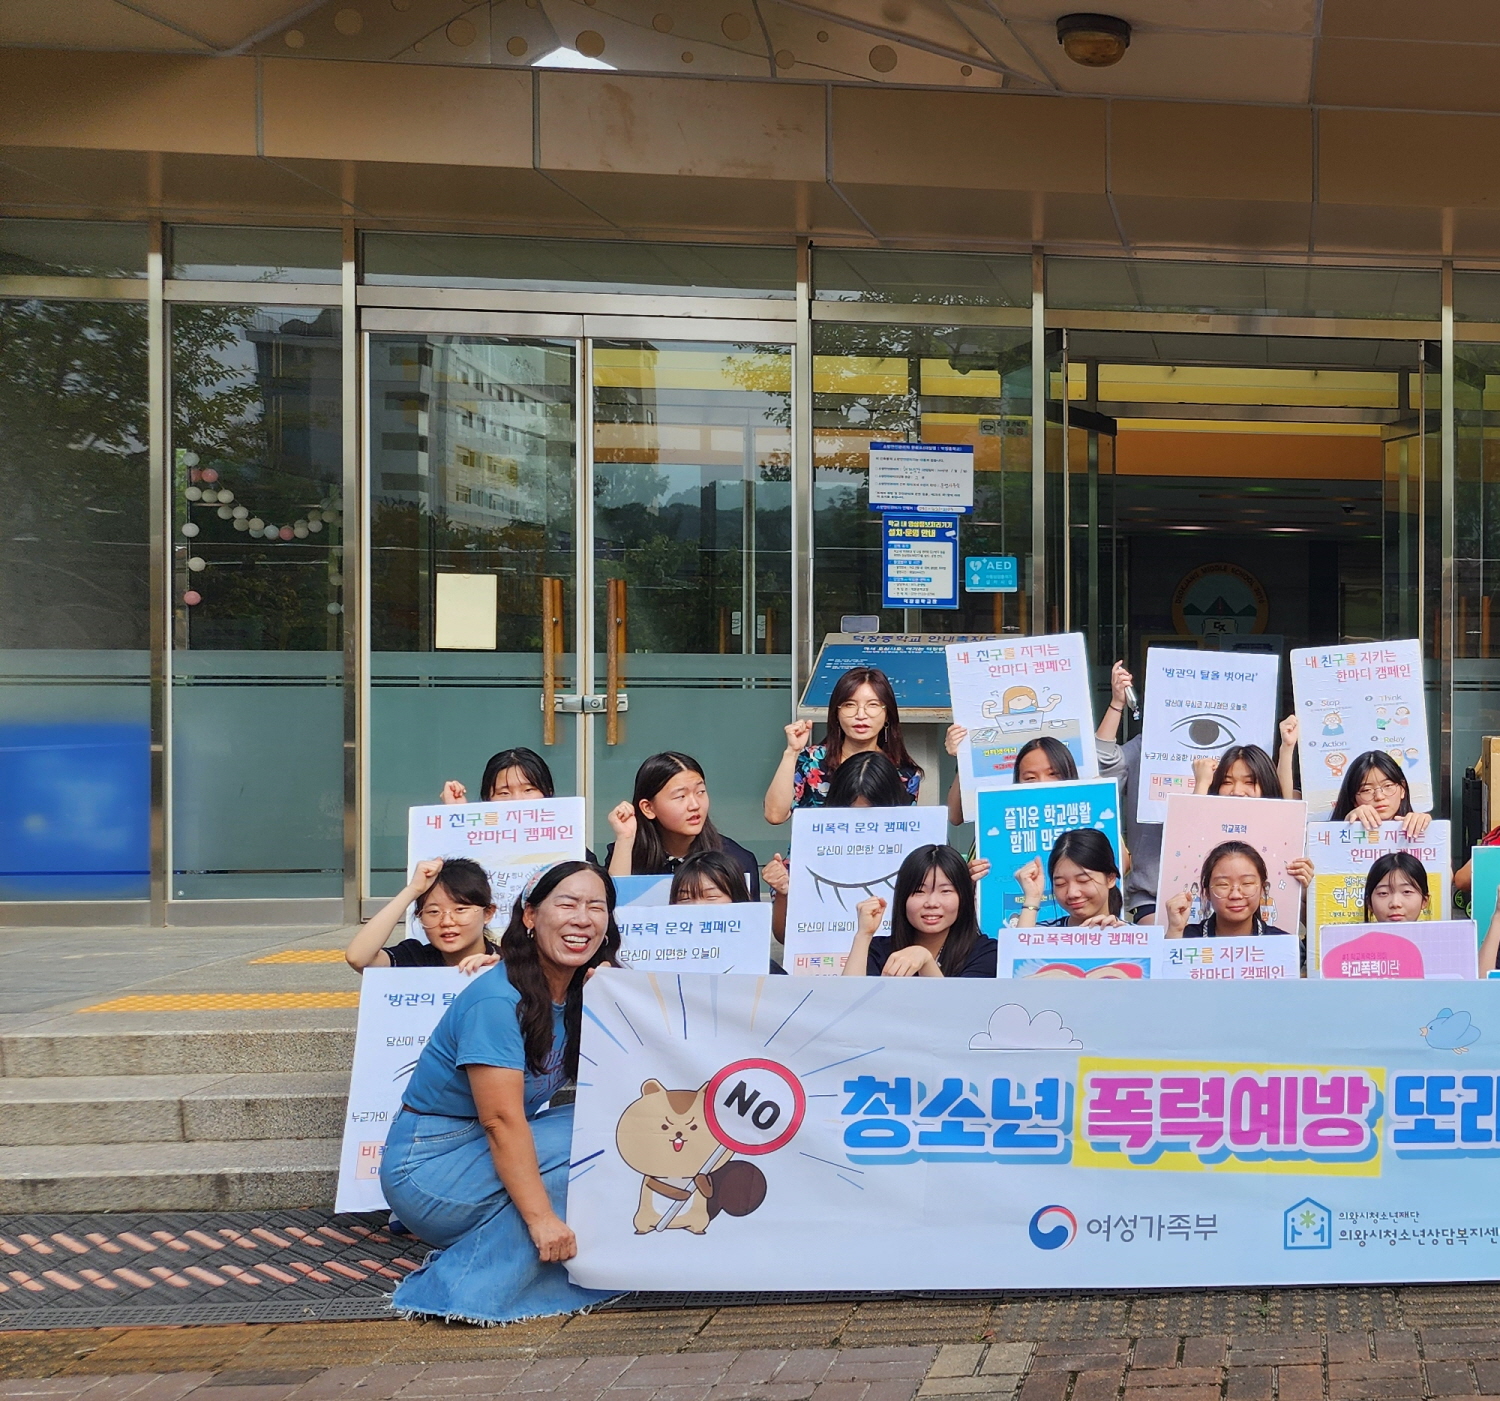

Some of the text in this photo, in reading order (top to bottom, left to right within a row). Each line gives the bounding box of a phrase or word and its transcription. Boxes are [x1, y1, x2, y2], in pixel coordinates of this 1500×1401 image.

[987, 561, 1012, 570] AED
[957, 651, 970, 664] 내
[976, 649, 1016, 662] 친구를
[1021, 644, 1060, 658] 지키는
[1305, 649, 1397, 668] 내 친구를 지키는
[988, 659, 1072, 678] 한마디 캠페인
[1200, 670, 1220, 681] 탈을
[1336, 664, 1411, 683] 한마디 캠페인
[1320, 699, 1340, 708] Stop
[1379, 694, 1403, 702] Think
[1322, 740, 1347, 748] Action
[1383, 735, 1406, 744] Relay
[1170, 753, 1188, 761] 소중한
[426, 808, 556, 829] 내 친구를 지키는
[1005, 802, 1091, 830] 즐거운 학교생활
[812, 820, 920, 834] 비폭력 문화 캠페인
[1222, 824, 1247, 834] 학교폭력
[467, 825, 573, 846] 한마디 캠페인
[1010, 829, 1037, 854] 함께
[1318, 831, 1330, 845] 내
[1339, 830, 1381, 844] 친구를
[817, 844, 903, 856] 당신이 외면한 오늘이
[618, 920, 741, 936] 비폭력 문화 캠페인
[797, 921, 825, 933] 당신의
[828, 921, 855, 932] 내일이
[1018, 932, 1149, 946] 학교폭력예방 캠페인
[620, 946, 720, 962] 당신이 외면한 오늘이
[1169, 946, 1265, 965] 친구를 지키는
[797, 957, 834, 968] 비폭력
[1341, 960, 1400, 977] 학교폭력이란
[386, 1036, 414, 1047] 당신이
[723, 1080, 781, 1130] NO
[841, 1074, 1059, 1149] 청소년
[1087, 1075, 1371, 1149] 폭력예방
[351, 1111, 388, 1123] 누군가의
[1338, 1211, 1420, 1224] 의왕시청소년재단
[1086, 1213, 1219, 1243] 여성가족부
